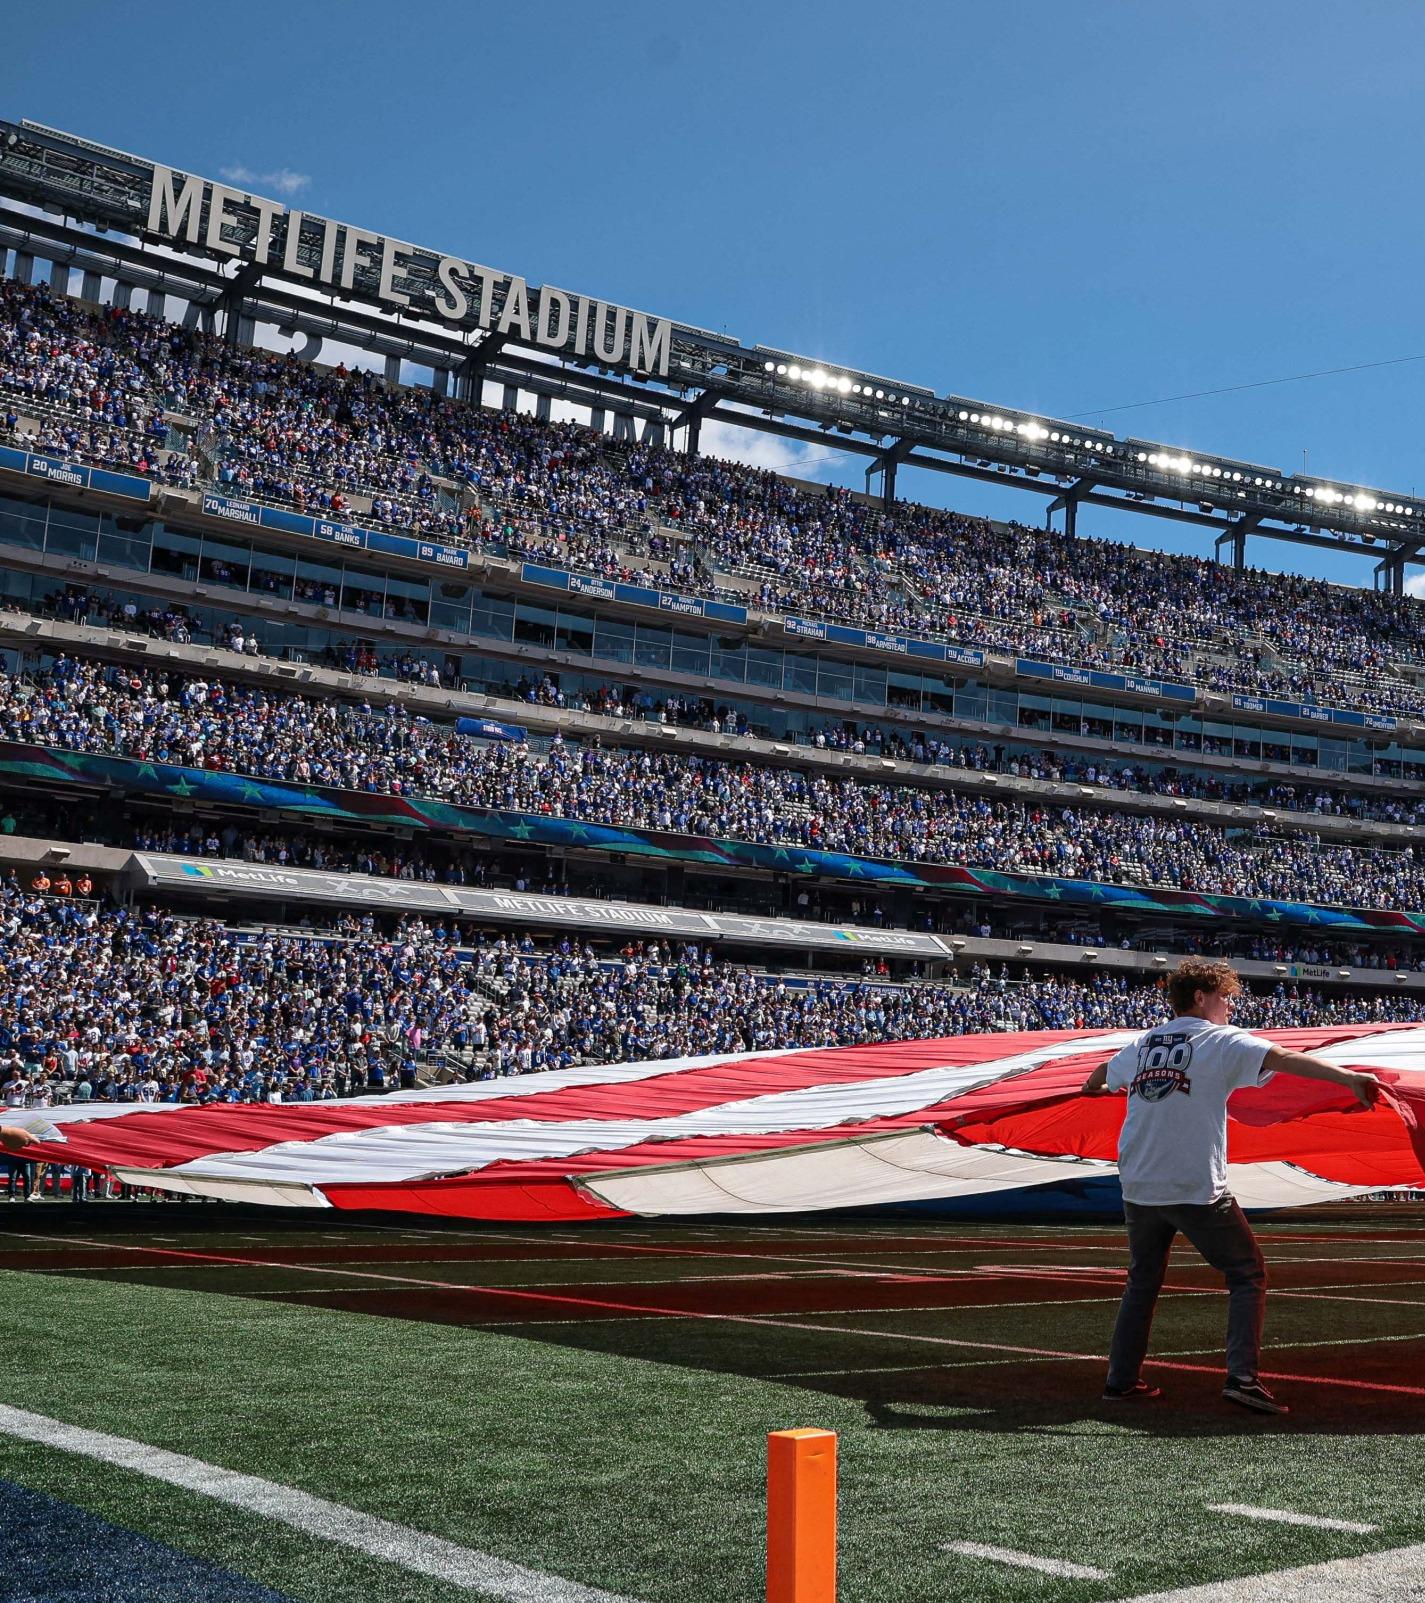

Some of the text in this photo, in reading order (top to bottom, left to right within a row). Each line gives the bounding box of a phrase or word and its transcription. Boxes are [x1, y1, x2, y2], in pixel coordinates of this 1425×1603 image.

[147, 166, 673, 377] METLIFE STADIUM
[32, 459, 48, 472] 20
[60, 463, 72, 472] JOE
[47, 467, 83, 485] MORRIS
[205, 498, 219, 510] 70
[226, 500, 250, 511] LEONARD
[217, 505, 258, 523] MARSHALL
[320, 524, 333, 536] 58
[334, 531, 360, 545] BANKS
[421, 546, 433, 557] 89
[436, 552, 464, 567] BAVARO
[570, 577, 581, 588] 24
[580, 583, 613, 599] ANDERSON
[661, 596, 673, 606] 27
[671, 601, 702, 615] HAMPTON
[786, 620, 797, 629] 92
[796, 625, 824, 638] STRAHAN
[867, 635, 877, 645] 98
[875, 640, 906, 652] ARMSTEAD
[956, 654, 981, 666] ACCORSI
[1063, 672, 1089, 684] COUGHLIN
[1127, 680, 1135, 688] 10
[1135, 684, 1160, 695] MANNING
[1234, 697, 1242, 706] 81
[1243, 701, 1264, 711] TOOMER
[1303, 707, 1310, 716] 21
[1310, 711, 1329, 721] BARBER
[1365, 717, 1373, 725] 72
[216, 868, 299, 886] MetLife
[493, 896, 674, 925] METLIFE STADIUM
[858, 933, 916, 946] MetLife
[1302, 968, 1330, 978] MetLife
[1162, 1035, 1173, 1044] ny
[1137, 1042, 1192, 1074] 100
[1136, 1069, 1181, 1081] SEASONS
